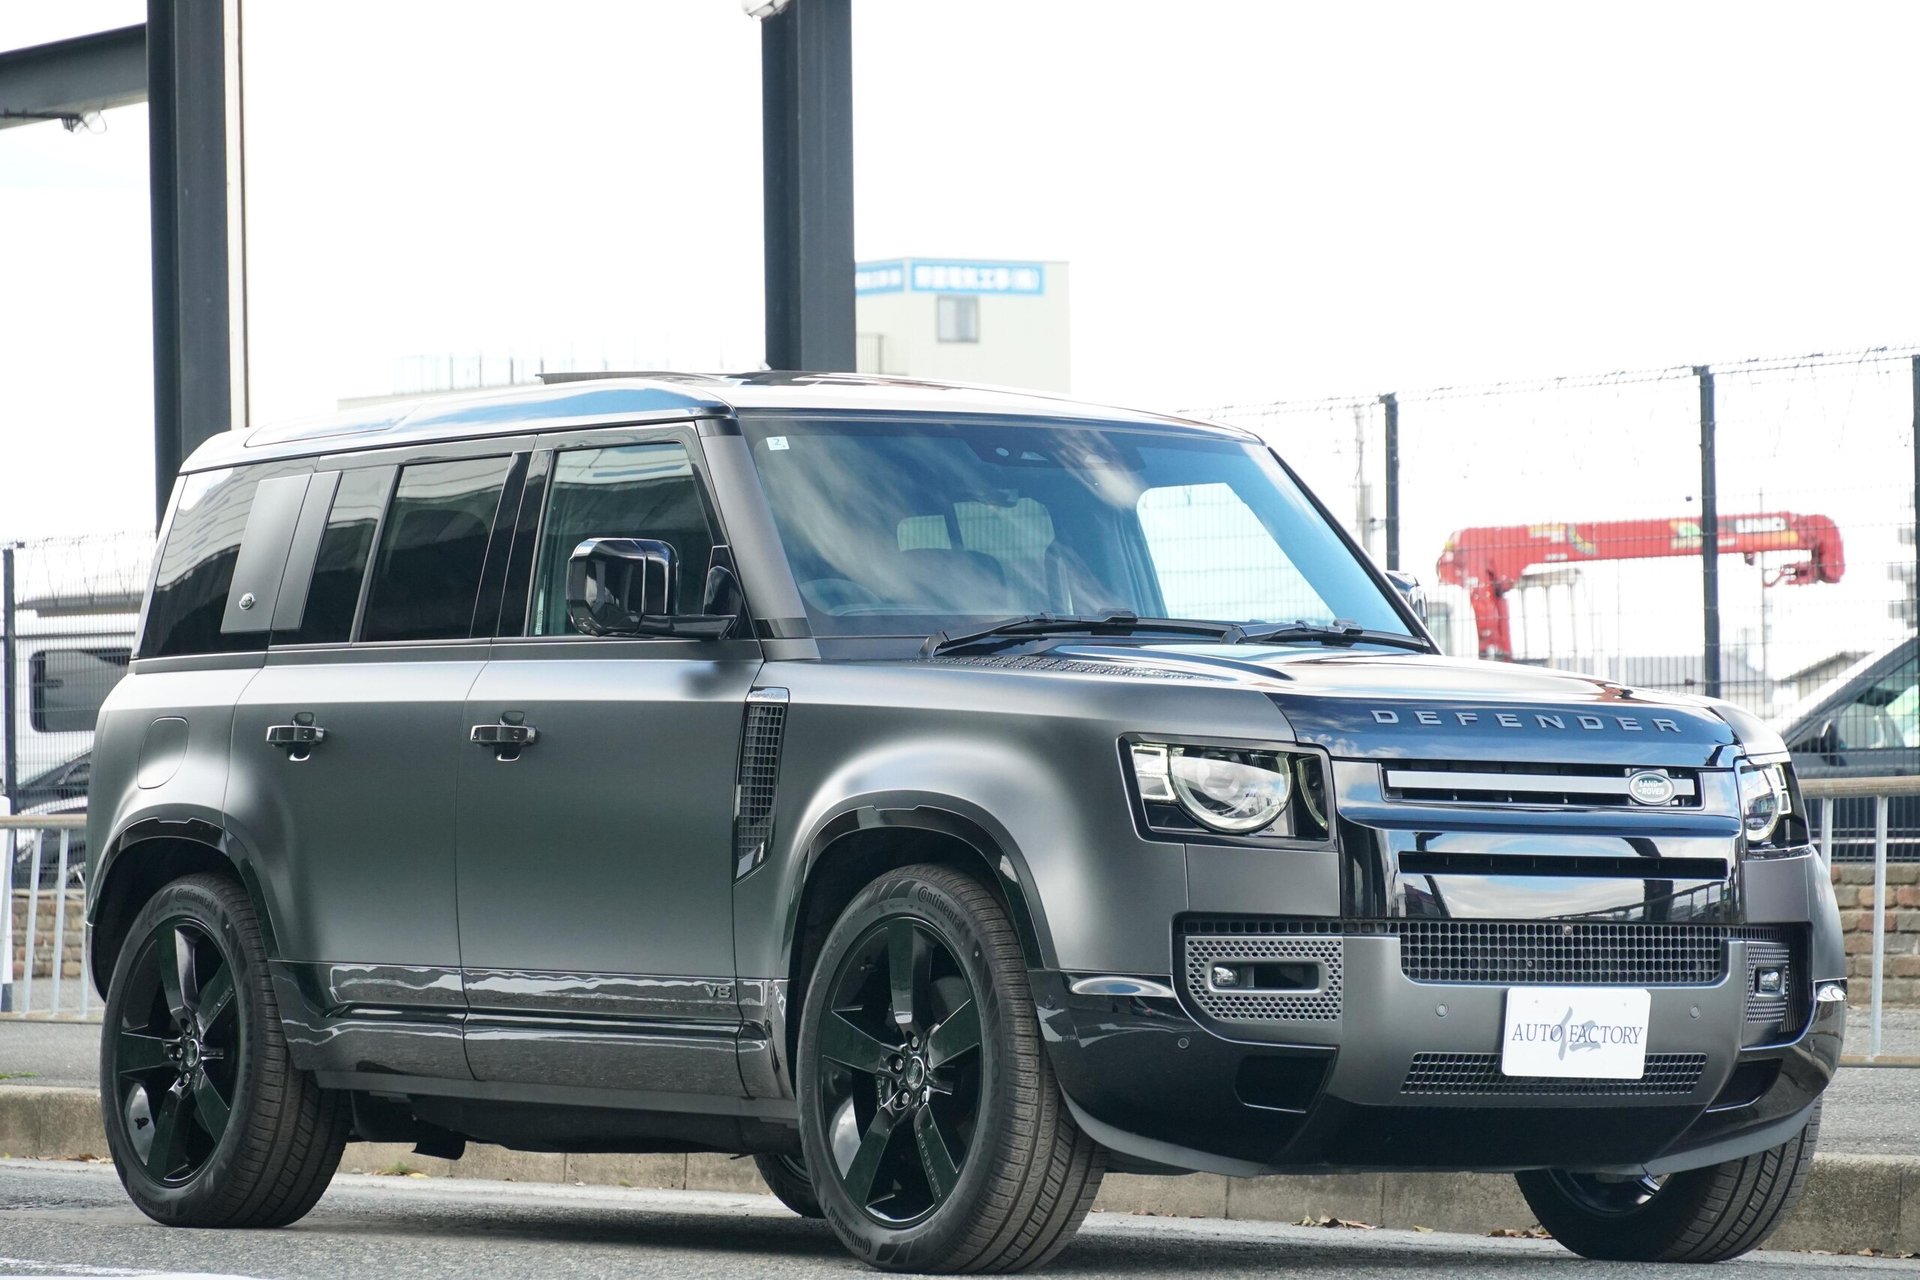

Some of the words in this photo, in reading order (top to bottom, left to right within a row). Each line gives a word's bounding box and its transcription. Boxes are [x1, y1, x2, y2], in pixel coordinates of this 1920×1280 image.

[1371, 710, 1681, 732] DEFENDER
[1639, 780, 1658, 788] LAND
[1641, 787, 1665, 796] ROVER
[917, 886, 967, 934] Continental
[704, 985, 731, 998] V8
[1511, 1023, 1563, 1043] AUTO
[1569, 1024, 1643, 1045] FACTORY
